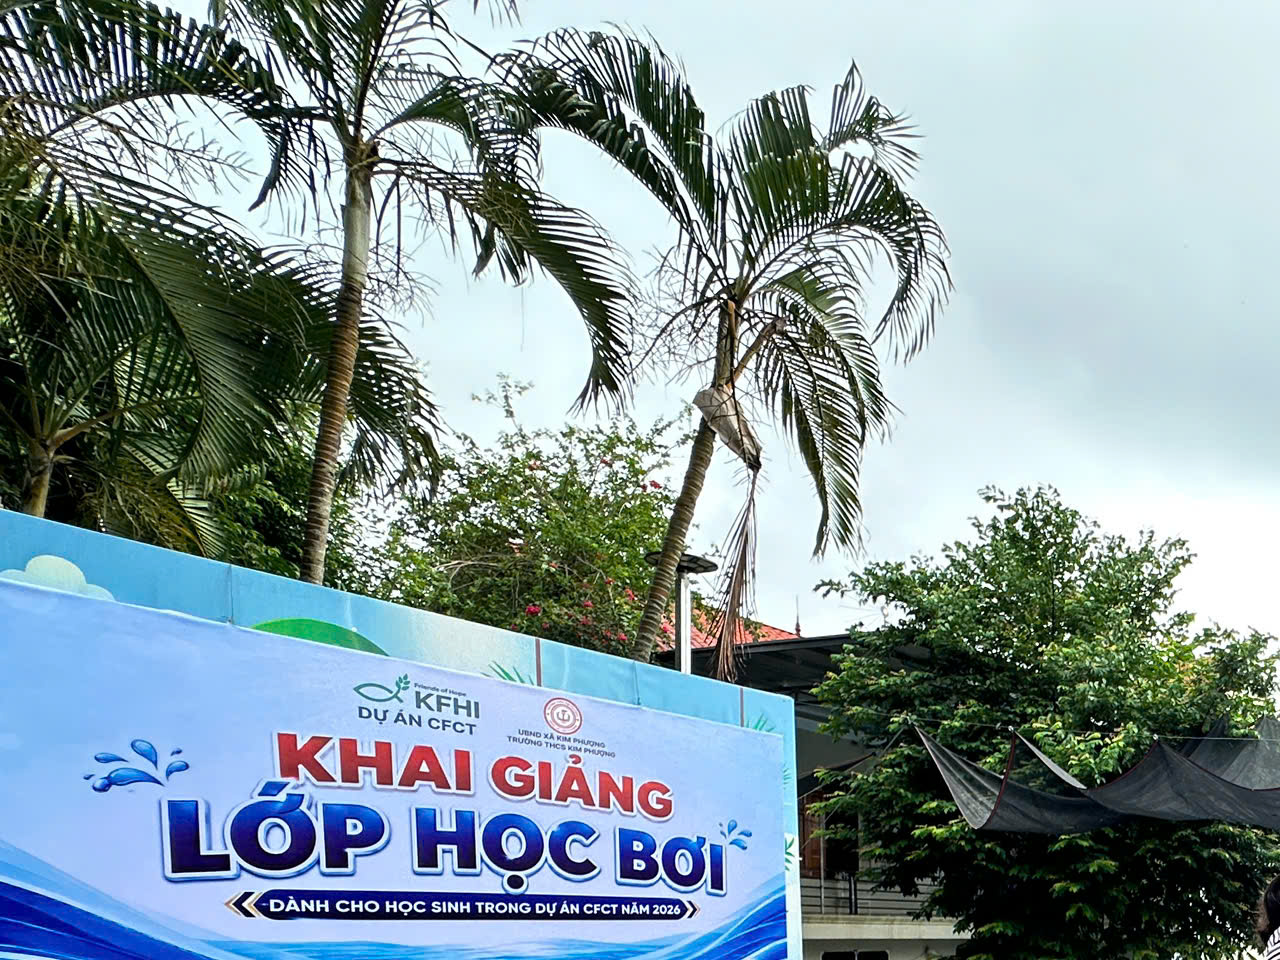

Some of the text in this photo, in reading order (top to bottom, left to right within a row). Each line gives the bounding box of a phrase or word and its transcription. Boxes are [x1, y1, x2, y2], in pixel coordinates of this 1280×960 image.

[415, 690, 480, 719] KFHI
[358, 706, 477, 735] DỰ ÁN CFCT
[518, 729, 542, 738] UBND
[556, 735, 572, 743] KIM
[544, 741, 567, 751] THCS
[567, 745, 583, 753] KIM
[277, 732, 673, 819] KHAI GIẢNG
[166, 780, 725, 892] LỚP HỌC BƠI
[269, 896, 681, 917] DÀNH CHO HỌC SINH TRONG DỰ ÁN CFCT NĂM 2026
